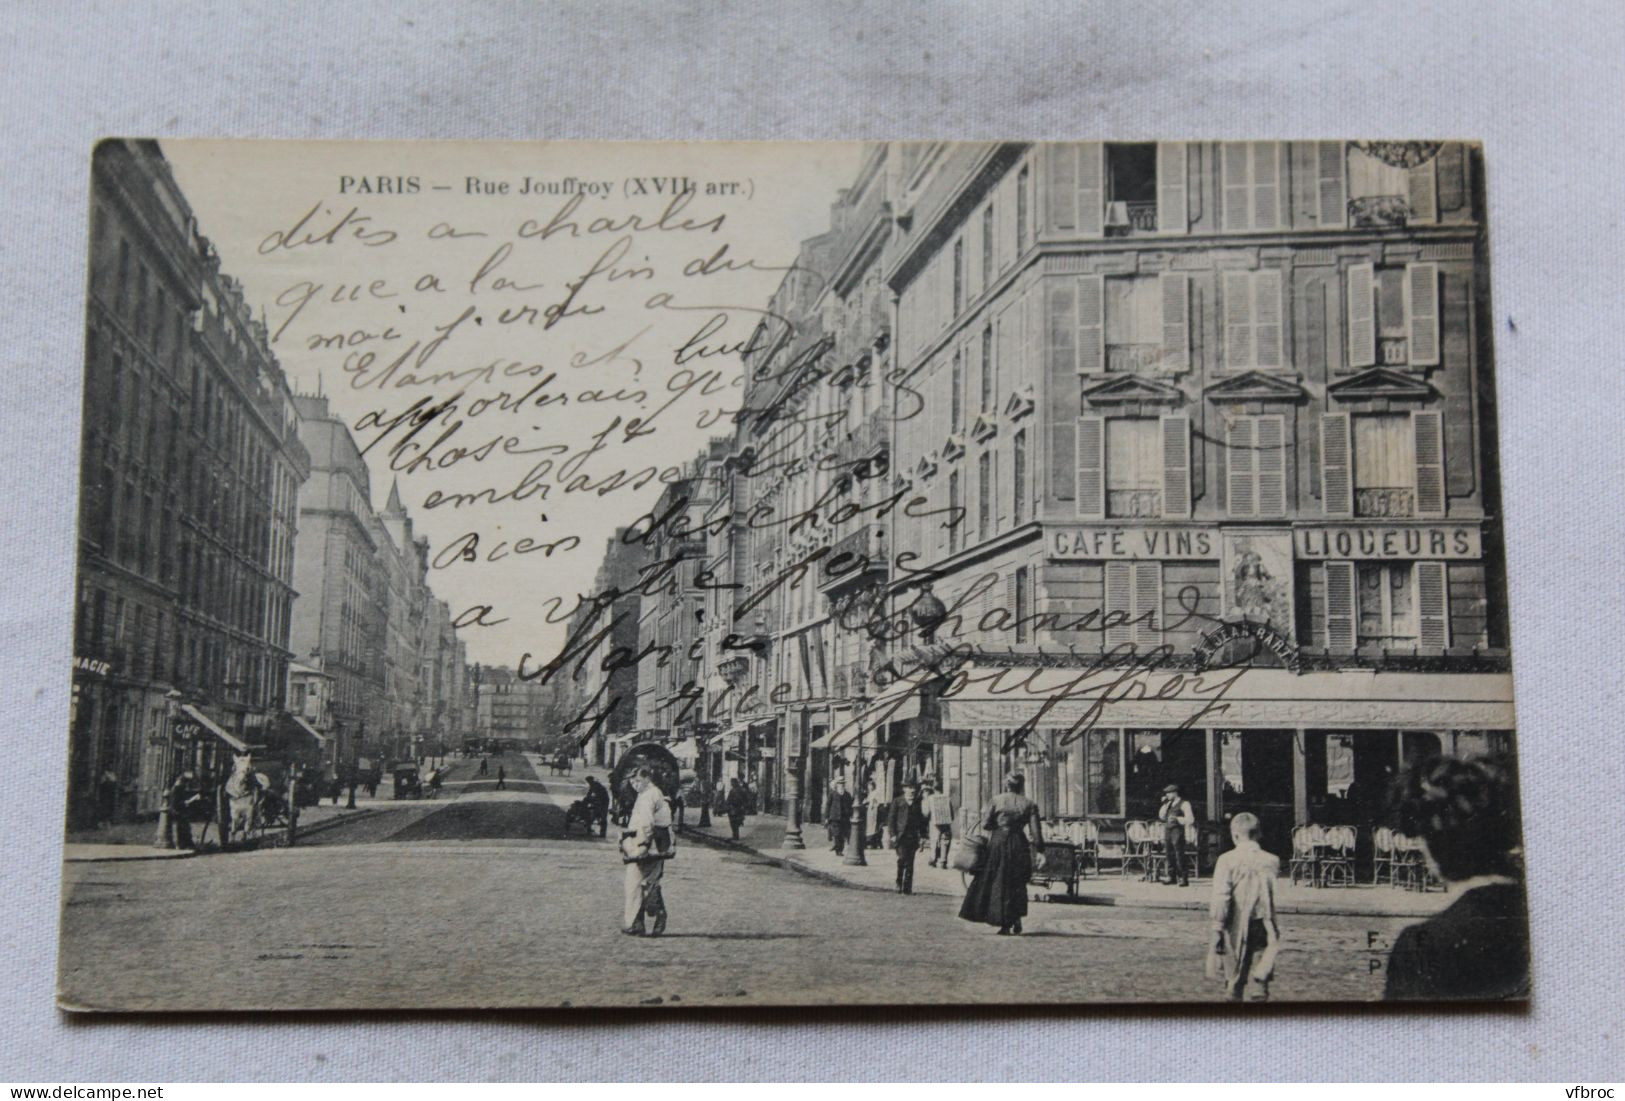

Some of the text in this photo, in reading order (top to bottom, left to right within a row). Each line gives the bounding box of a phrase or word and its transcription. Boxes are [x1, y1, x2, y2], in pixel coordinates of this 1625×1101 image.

[338, 176, 421, 195] PARIS
[465, 176, 510, 195] Rue
[519, 176, 614, 200] Jouffroy
[705, 178, 755, 200] arr.)
[276, 281, 398, 343] que
[470, 243, 544, 294] la
[622, 496, 731, 545] des
[748, 475, 966, 534] choses
[1055, 526, 1211, 555] CAFÉ VINS
[1304, 529, 1470, 557] LIQUEURS
[543, 552, 746, 623] votre
[518, 595, 766, 685] Marie
